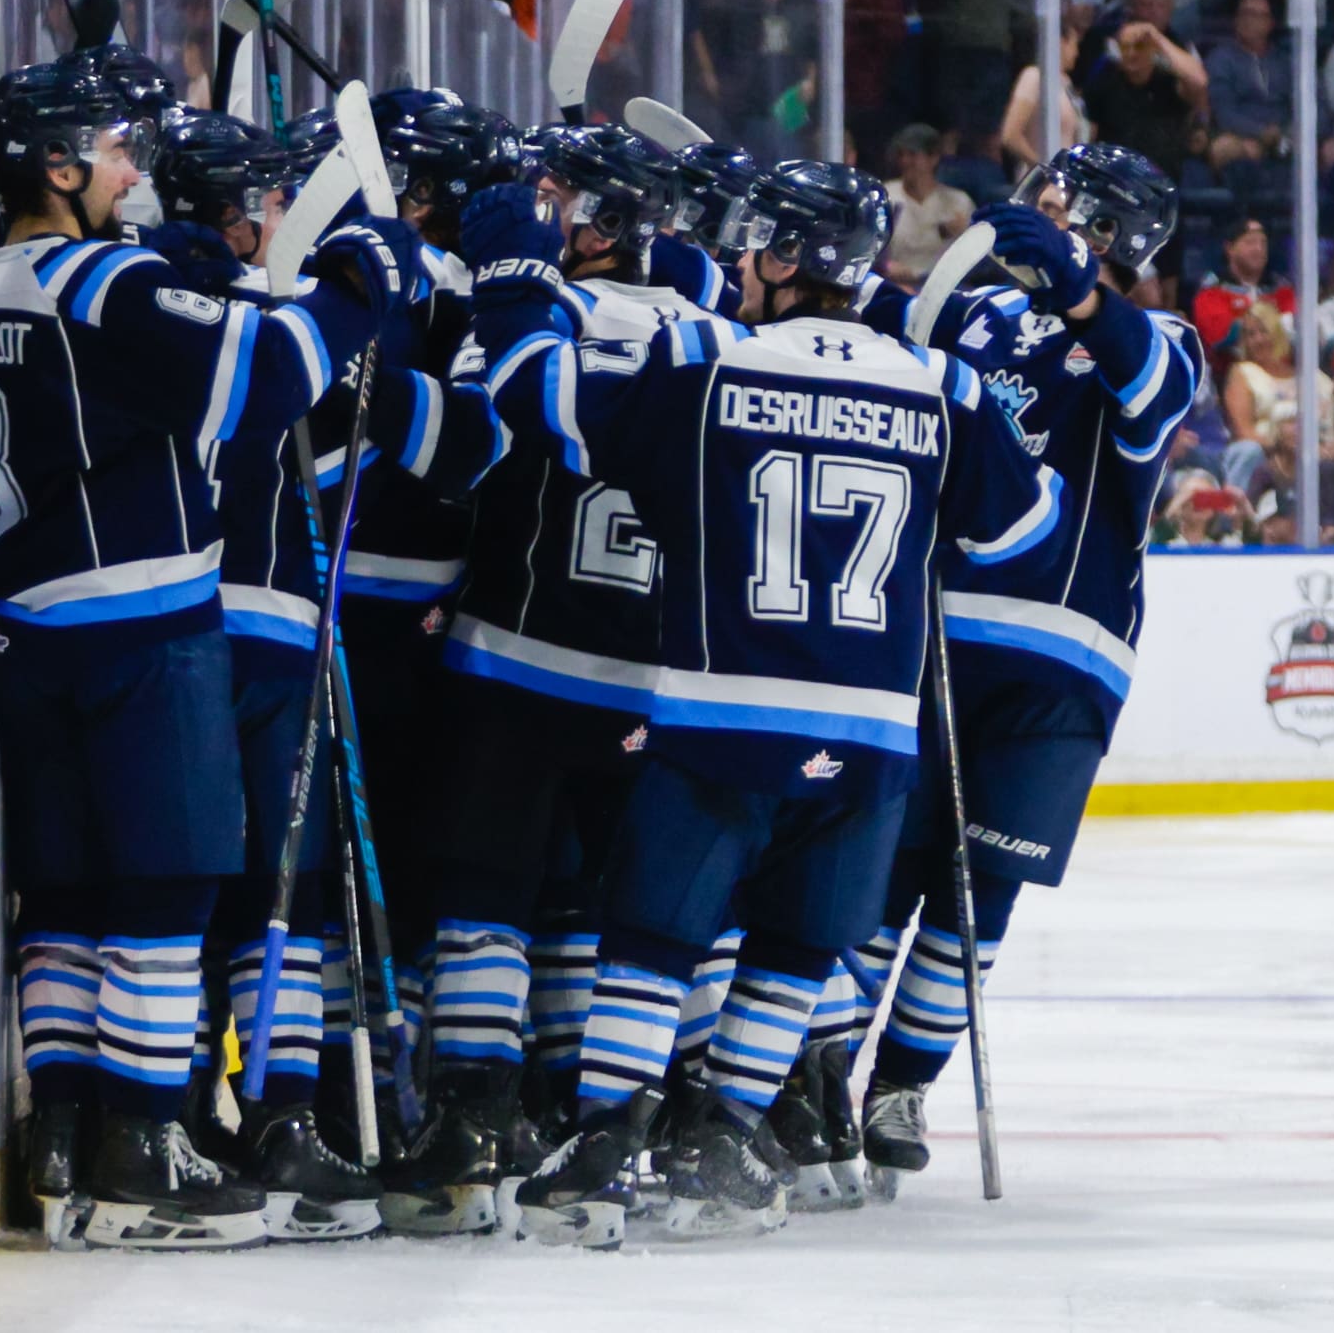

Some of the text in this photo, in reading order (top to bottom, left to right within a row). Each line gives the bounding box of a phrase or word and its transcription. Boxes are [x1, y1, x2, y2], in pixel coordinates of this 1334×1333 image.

[476, 257, 566, 292] AUER
[719, 383, 939, 457] DESRUISSEAUX
[748, 449, 911, 632] 17
[965, 822, 1051, 862] BAUER
